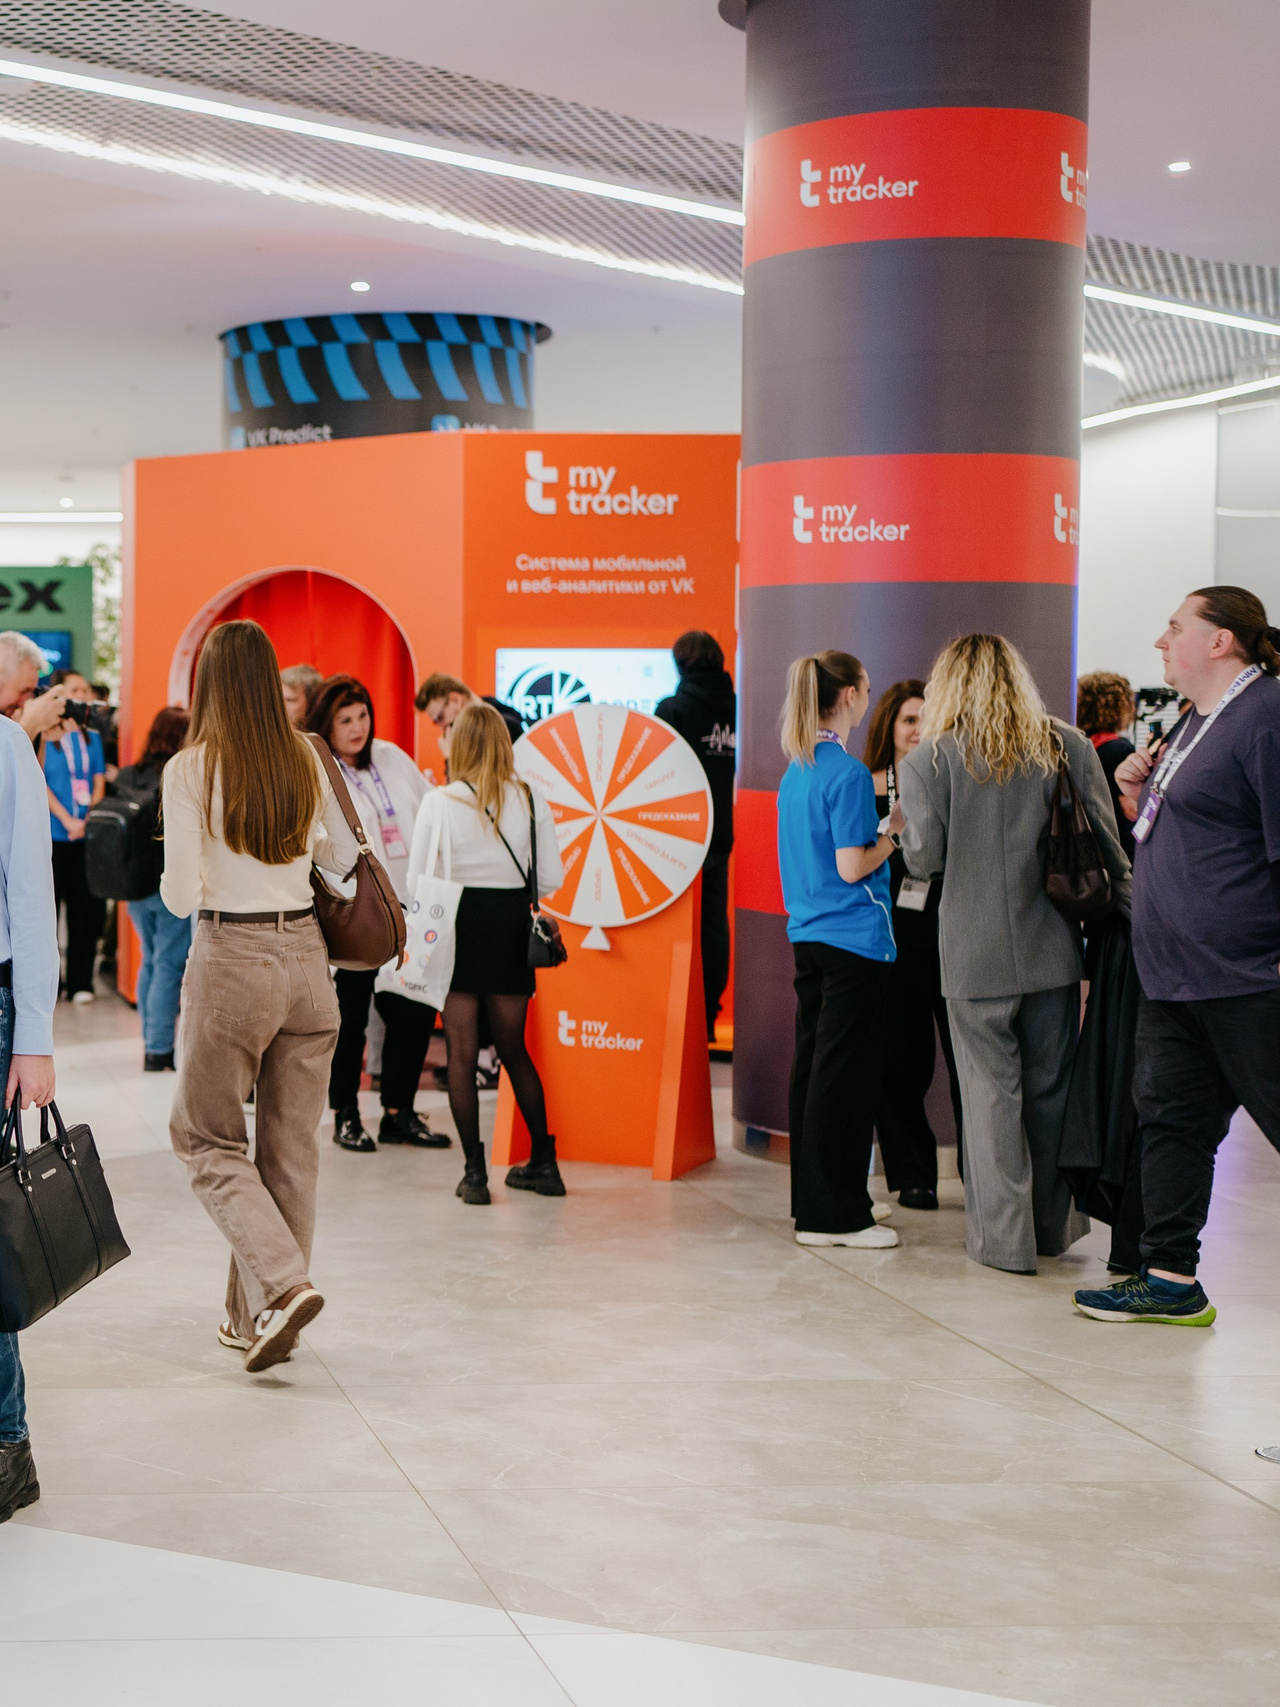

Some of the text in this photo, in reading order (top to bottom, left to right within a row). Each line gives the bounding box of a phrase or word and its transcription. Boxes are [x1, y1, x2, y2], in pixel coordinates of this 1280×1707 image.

[828, 162, 866, 186] my
[827, 175, 919, 204] tracker
[269, 423, 332, 446] Predict
[568, 465, 617, 496] my
[566, 484, 679, 516] tracker
[821, 503, 858, 526] my
[819, 517, 910, 543] tracker
[515, 553, 687, 572] Система мобильной
[506, 576, 696, 594] и веб-аналитики от VK
[637, 811, 701, 822] ПРЕДСКАЗАНИЕ
[581, 1020, 608, 1037] my
[580, 1031, 644, 1052] tracker
